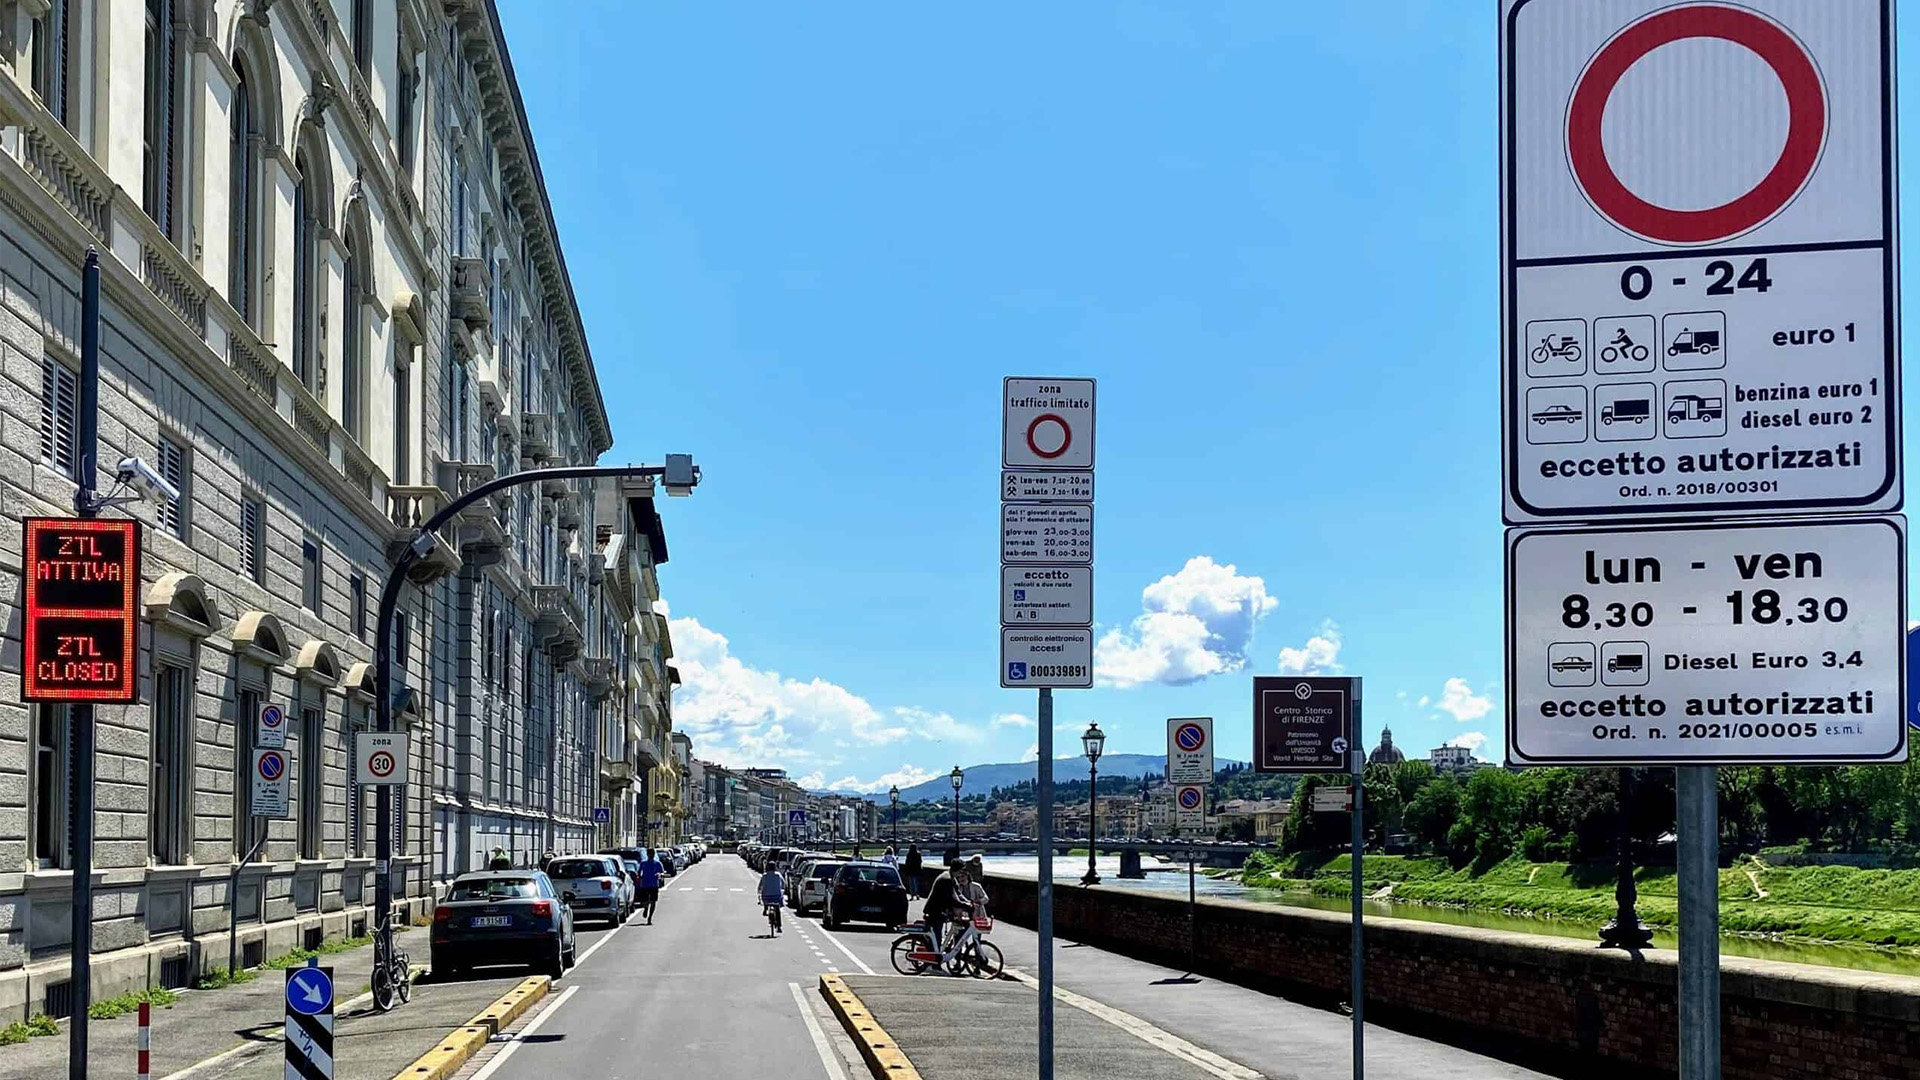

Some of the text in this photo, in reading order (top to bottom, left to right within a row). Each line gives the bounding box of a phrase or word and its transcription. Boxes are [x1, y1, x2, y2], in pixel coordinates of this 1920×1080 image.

[1621, 266, 1652, 300] 0
[1705, 258, 1772, 295] 24
[1773, 323, 1854, 346] euro 1
[1736, 378, 1877, 402] benzina euro 1
[1011, 398, 1089, 409] traffico limitato
[1741, 406, 1871, 428] diesel euro 2
[1540, 442, 1860, 477] eccetto autorizzati
[1619, 481, 1777, 497] Ord. n. 2018/00301
[59, 536, 102, 556] ZTL
[37, 561, 120, 581] ATTIVA
[1025, 570, 1069, 579] eccetto
[1586, 551, 1660, 584] lun
[1734, 552, 1821, 579] ven
[1562, 594, 1653, 630] 8,30
[1727, 589, 1847, 625] 18,30
[57, 637, 101, 656] ZTL
[1030, 644, 1064, 652] accessi
[38, 661, 117, 681] CLOSED
[1030, 665, 1086, 677] 800339891
[1665, 653, 1738, 670] Diesel
[1753, 653, 1808, 668] Euro
[1274, 706, 1333, 715] Centro Storico
[1540, 691, 1872, 717] eccetto autorizzati
[1292, 716, 1325, 724] FIRENZE
[1593, 725, 1636, 739] Ord.
[1649, 728, 1666, 739] n.
[1679, 723, 1817, 738] 2021/00005
[374, 758, 389, 770] 30
[1293, 755, 1318, 763] Heritage
